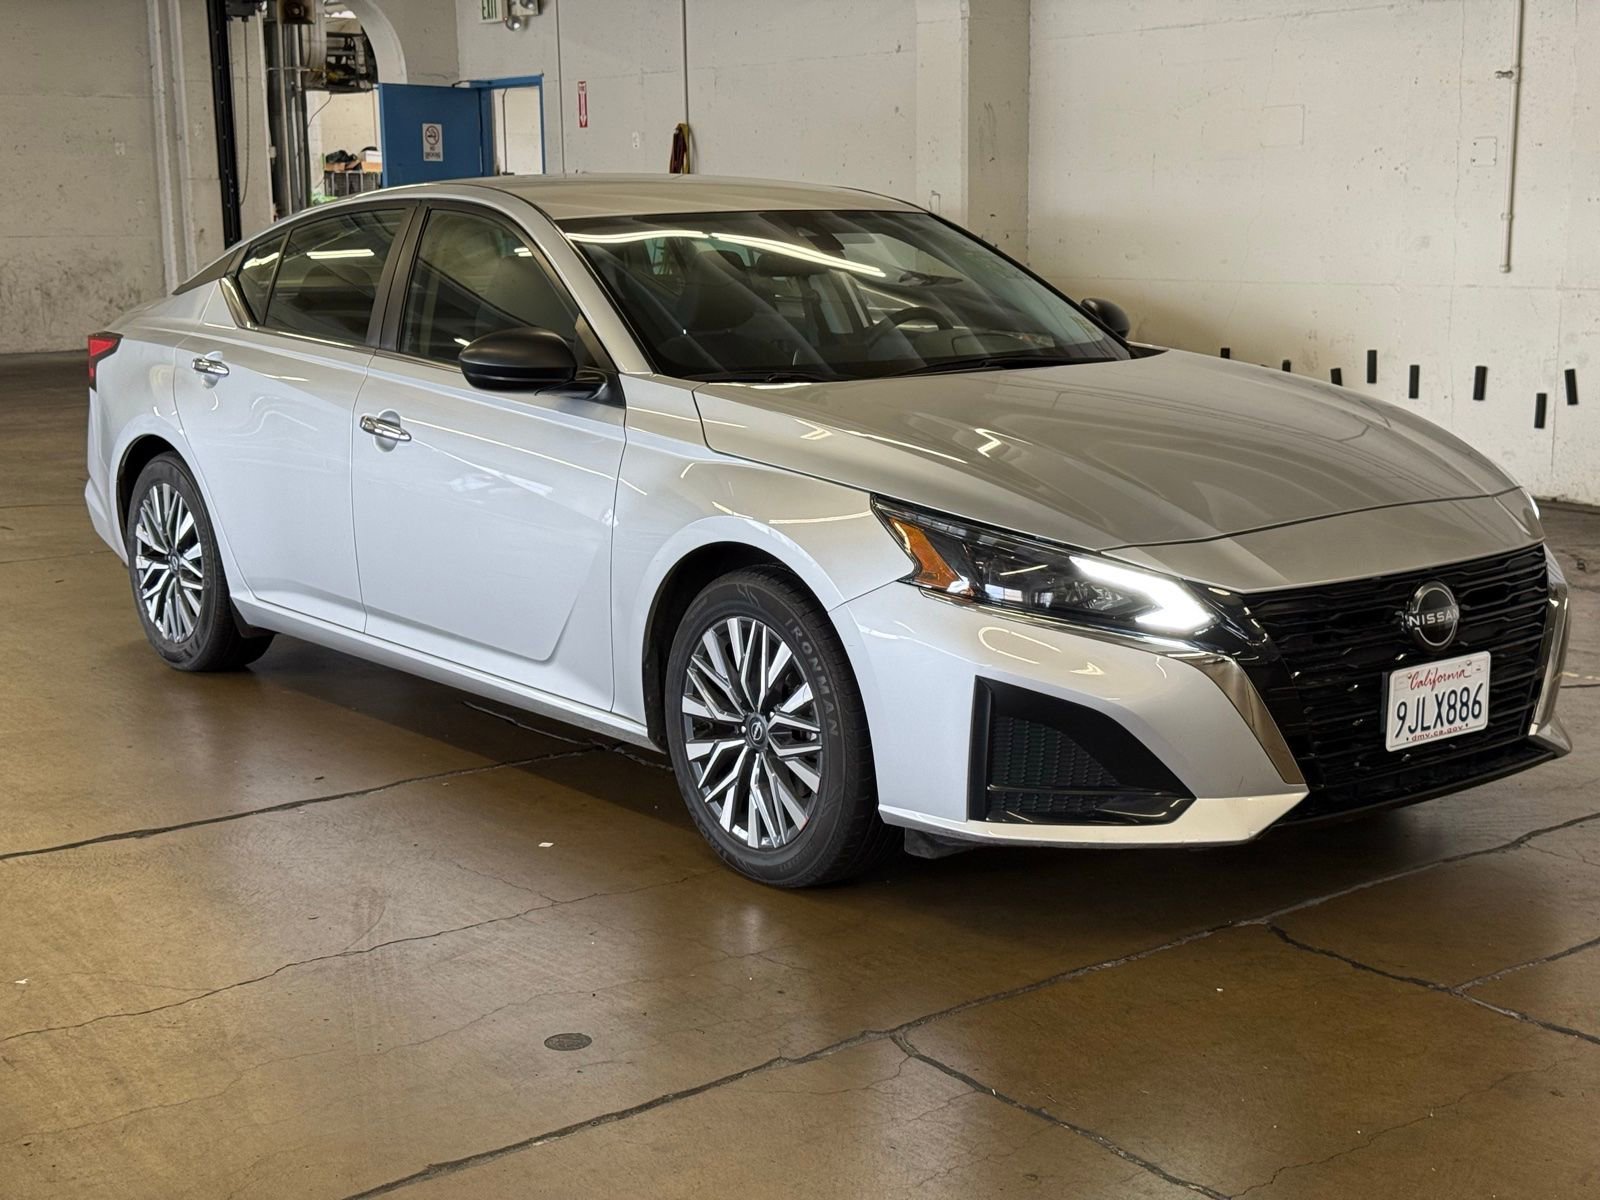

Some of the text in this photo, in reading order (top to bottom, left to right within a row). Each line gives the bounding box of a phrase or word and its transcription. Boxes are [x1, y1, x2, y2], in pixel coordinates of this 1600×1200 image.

[1408, 608, 1458, 627] NISSAN
[784, 617, 840, 737] IRONMAN
[1408, 667, 1472, 692] California
[1394, 682, 1484, 739] 9JLX886
